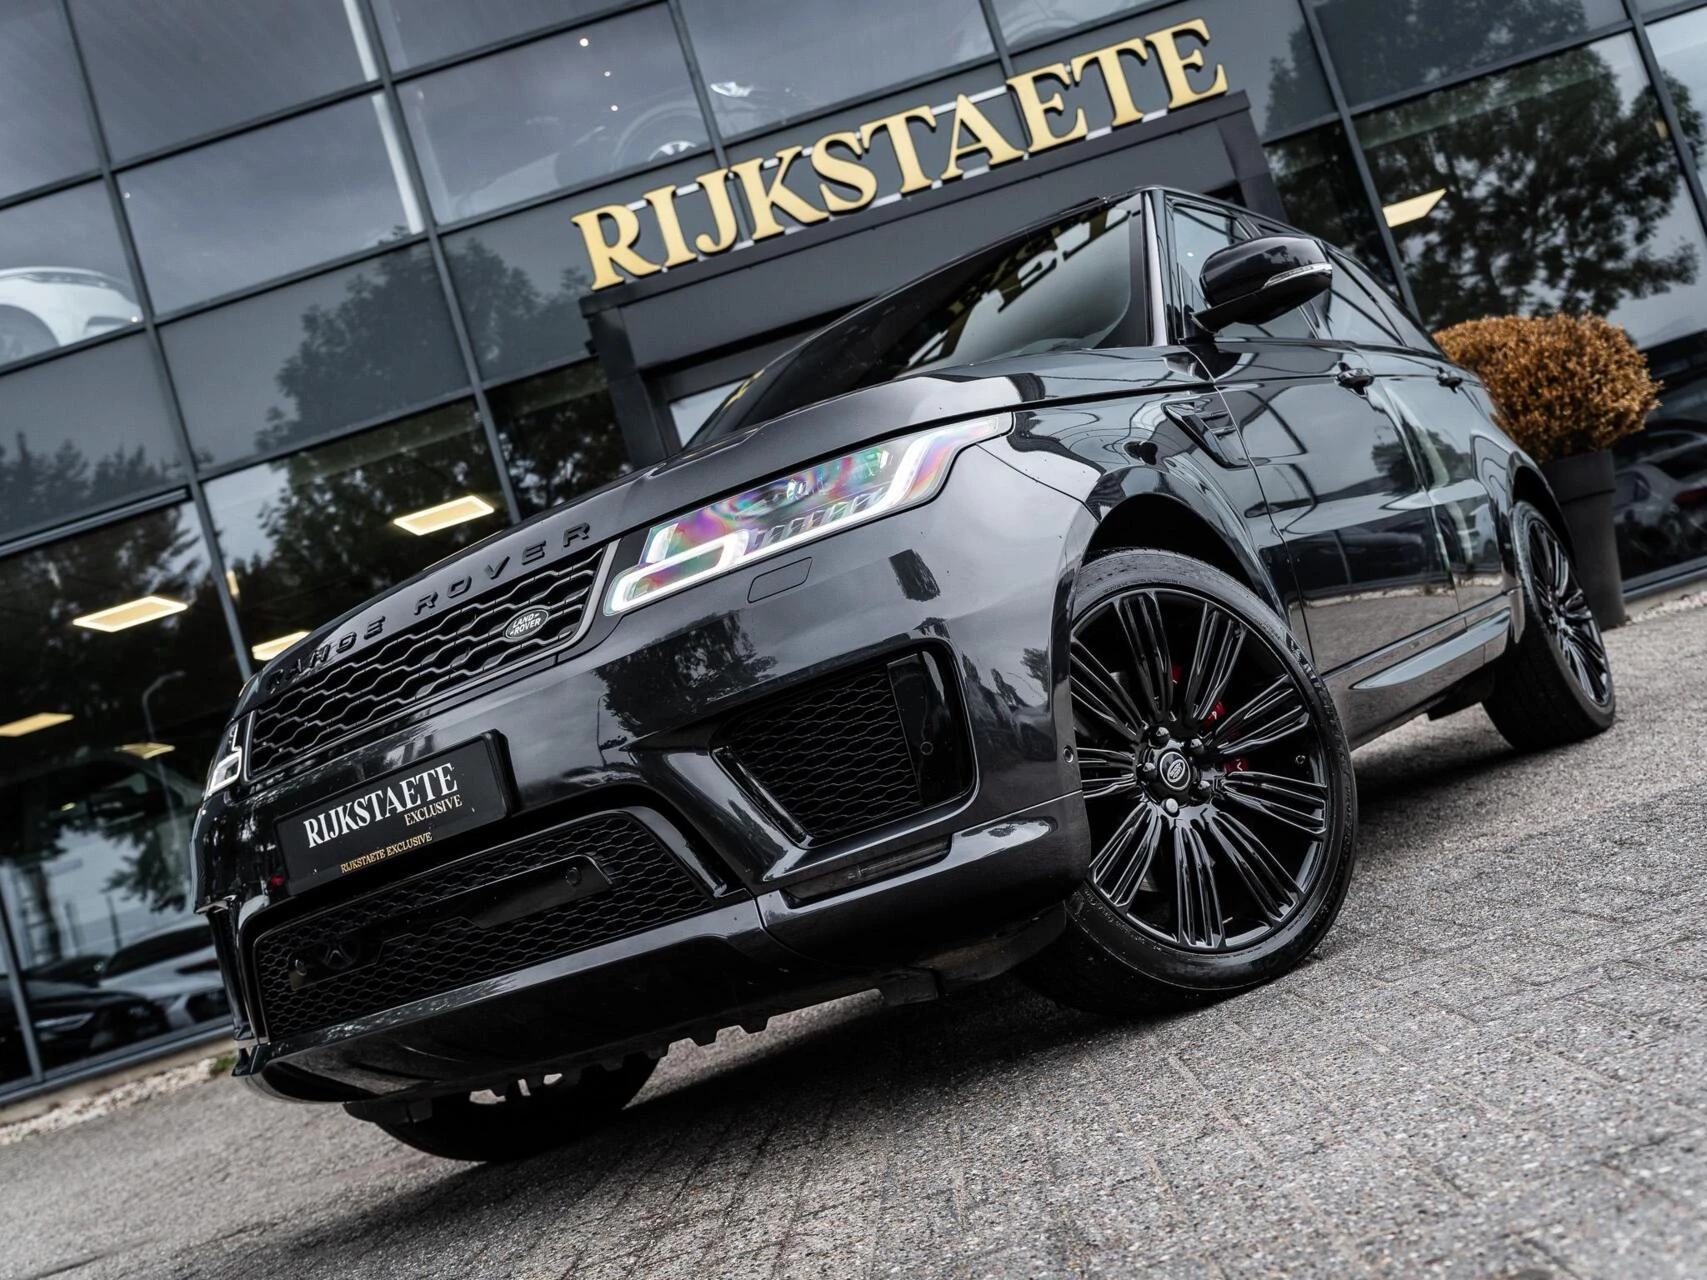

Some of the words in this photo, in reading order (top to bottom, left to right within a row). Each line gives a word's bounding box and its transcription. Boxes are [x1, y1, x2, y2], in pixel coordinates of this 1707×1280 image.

[572, 18, 1228, 291] RIJKSTAETE
[413, 522, 591, 615] ROVER
[303, 762, 458, 848] RIJKSTAETE
[404, 794, 463, 827] EXCLUSIVE
[340, 849, 386, 874] RIJKSTAETE
[386, 831, 433, 857] EXCLUSIVE
